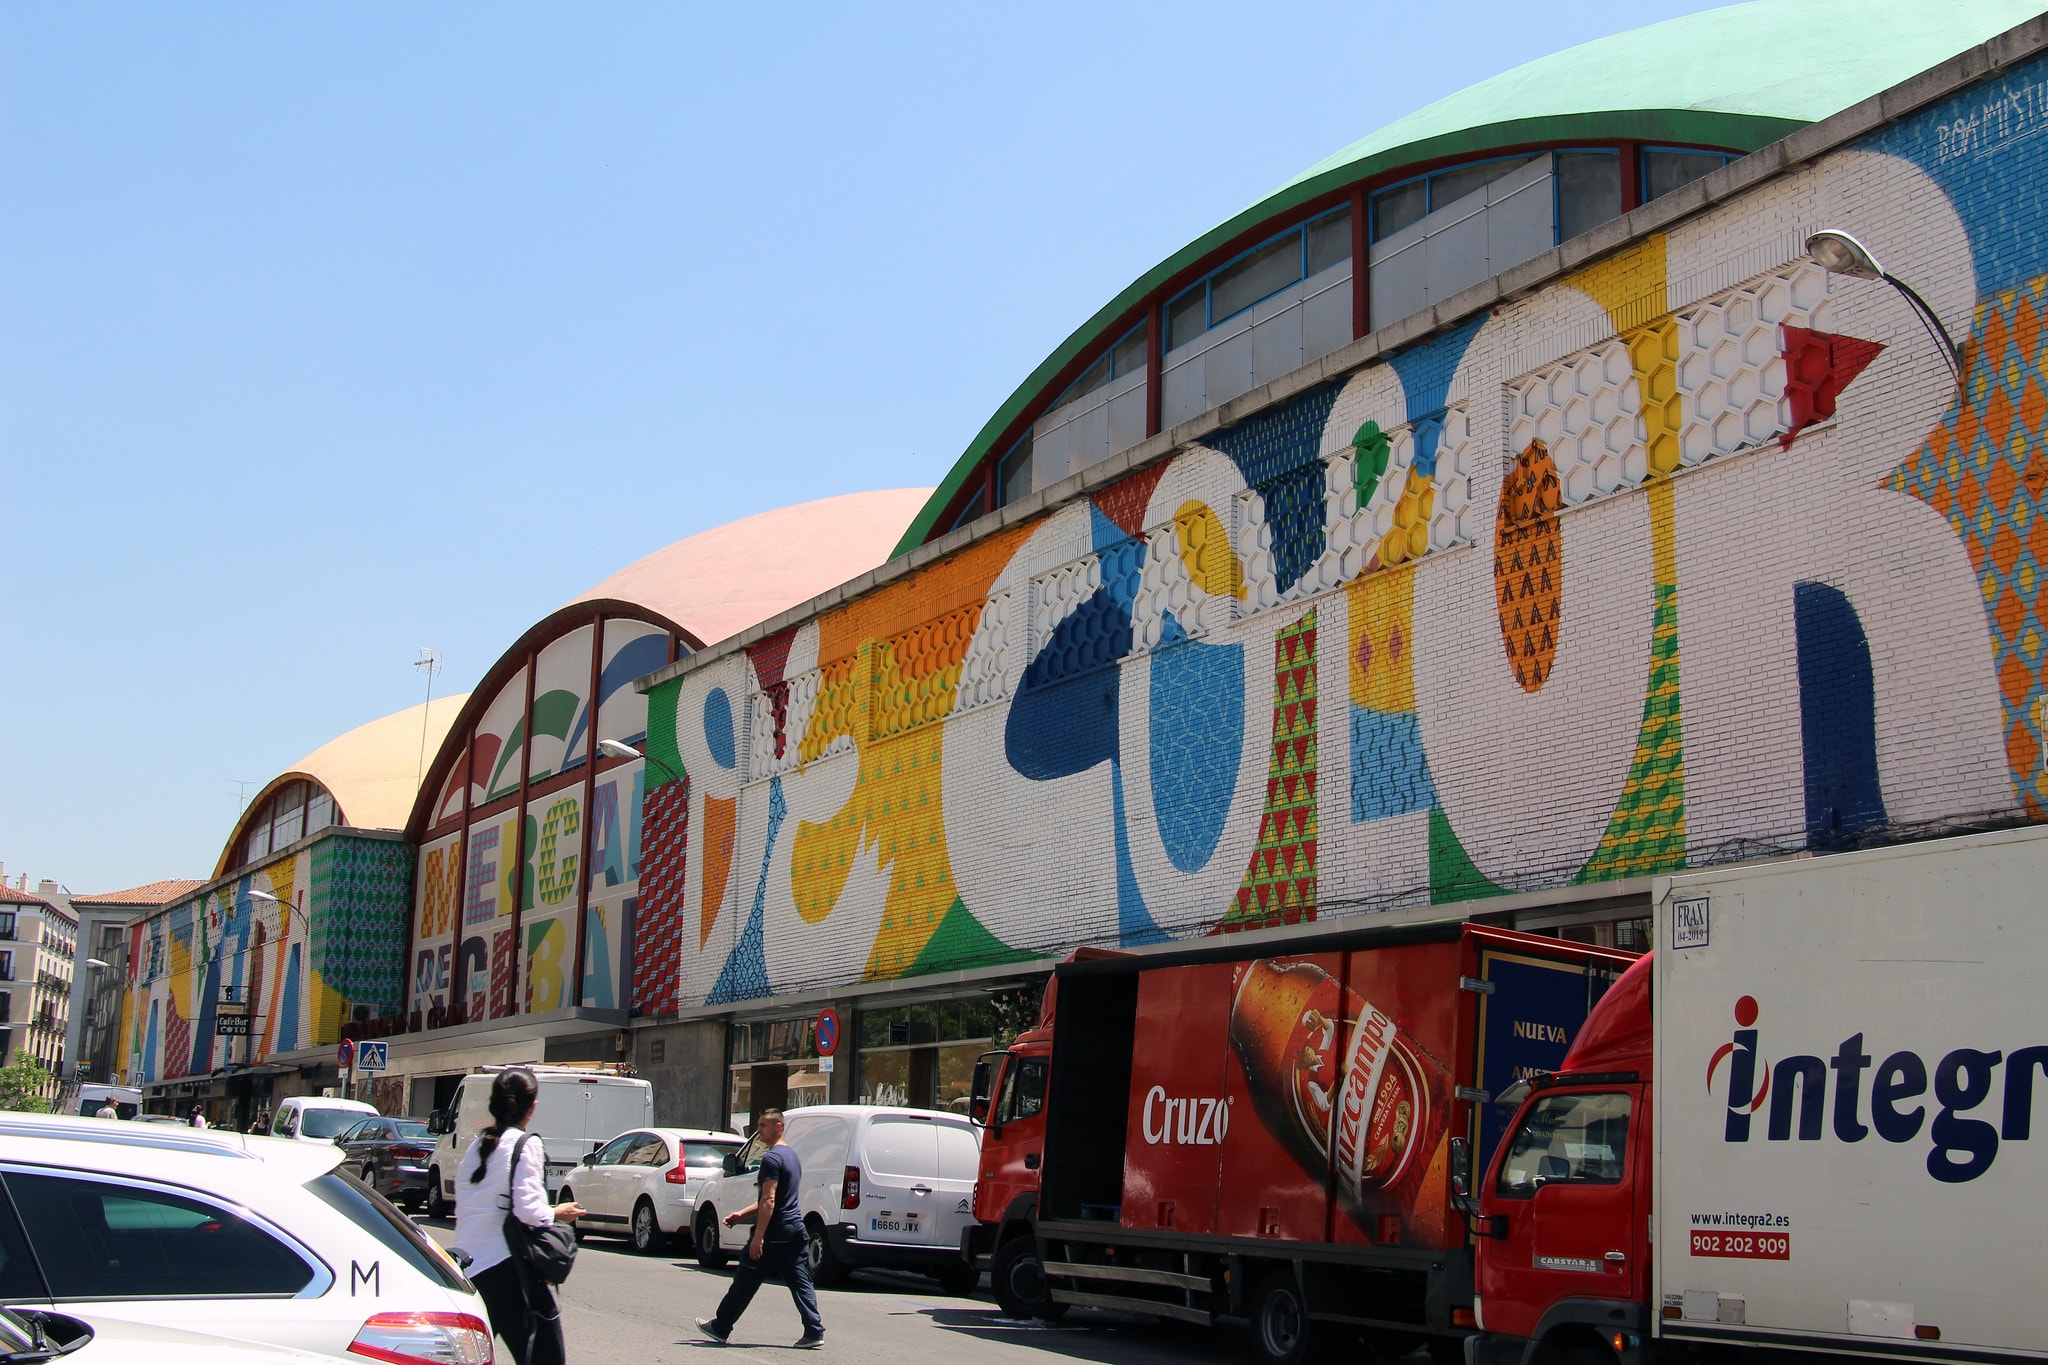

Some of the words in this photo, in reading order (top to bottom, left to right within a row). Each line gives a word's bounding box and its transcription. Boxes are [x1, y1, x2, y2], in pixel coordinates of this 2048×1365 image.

[1677, 902, 1704, 928] FRAX
[1677, 929, 1704, 942] 04-2019
[234, 1016, 248, 1026] Bar
[1513, 1021, 1567, 1044] NUEVA
[1377, 1074, 1397, 1107] 1904
[1722, 995, 2048, 1183] integr
[1374, 1110, 1390, 1140] CERVEZA
[1386, 1086, 1401, 1109] PILSEN
[877, 1220, 900, 1231] 6660
[902, 1222, 919, 1233] JWX
[1690, 1211, 1790, 1230] www.integra2.es
[1693, 1235, 1721, 1252] 902
[1724, 1236, 1753, 1253] 202
[1758, 1238, 1787, 1255] 909
[1540, 1257, 1597, 1267] CABSTAR.E
[350, 1260, 381, 1298] M
